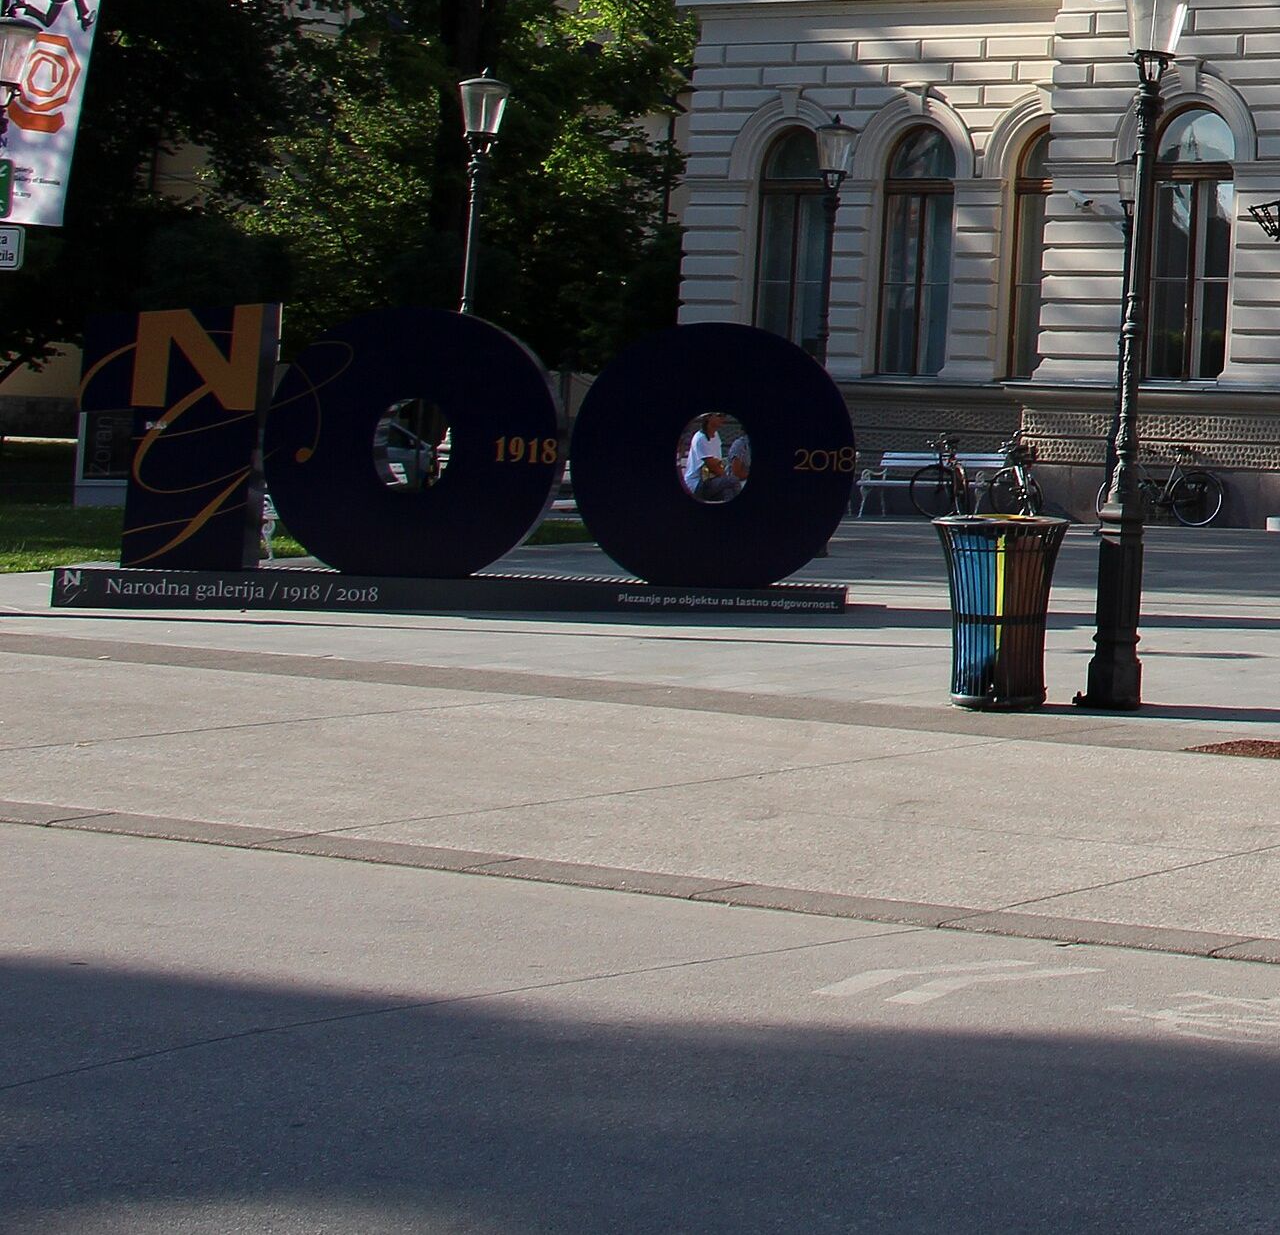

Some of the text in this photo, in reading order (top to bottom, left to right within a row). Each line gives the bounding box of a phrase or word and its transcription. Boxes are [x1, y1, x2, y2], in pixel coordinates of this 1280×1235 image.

[495, 435, 558, 464] 1918
[793, 446, 856, 474] 2018
[105, 577, 188, 596] Narodna
[195, 579, 265, 601] galerija
[282, 584, 321, 602] 1918
[336, 585, 378, 602] 2018
[617, 593, 839, 610] Plezanje po objektu na lastno odgovornost.
